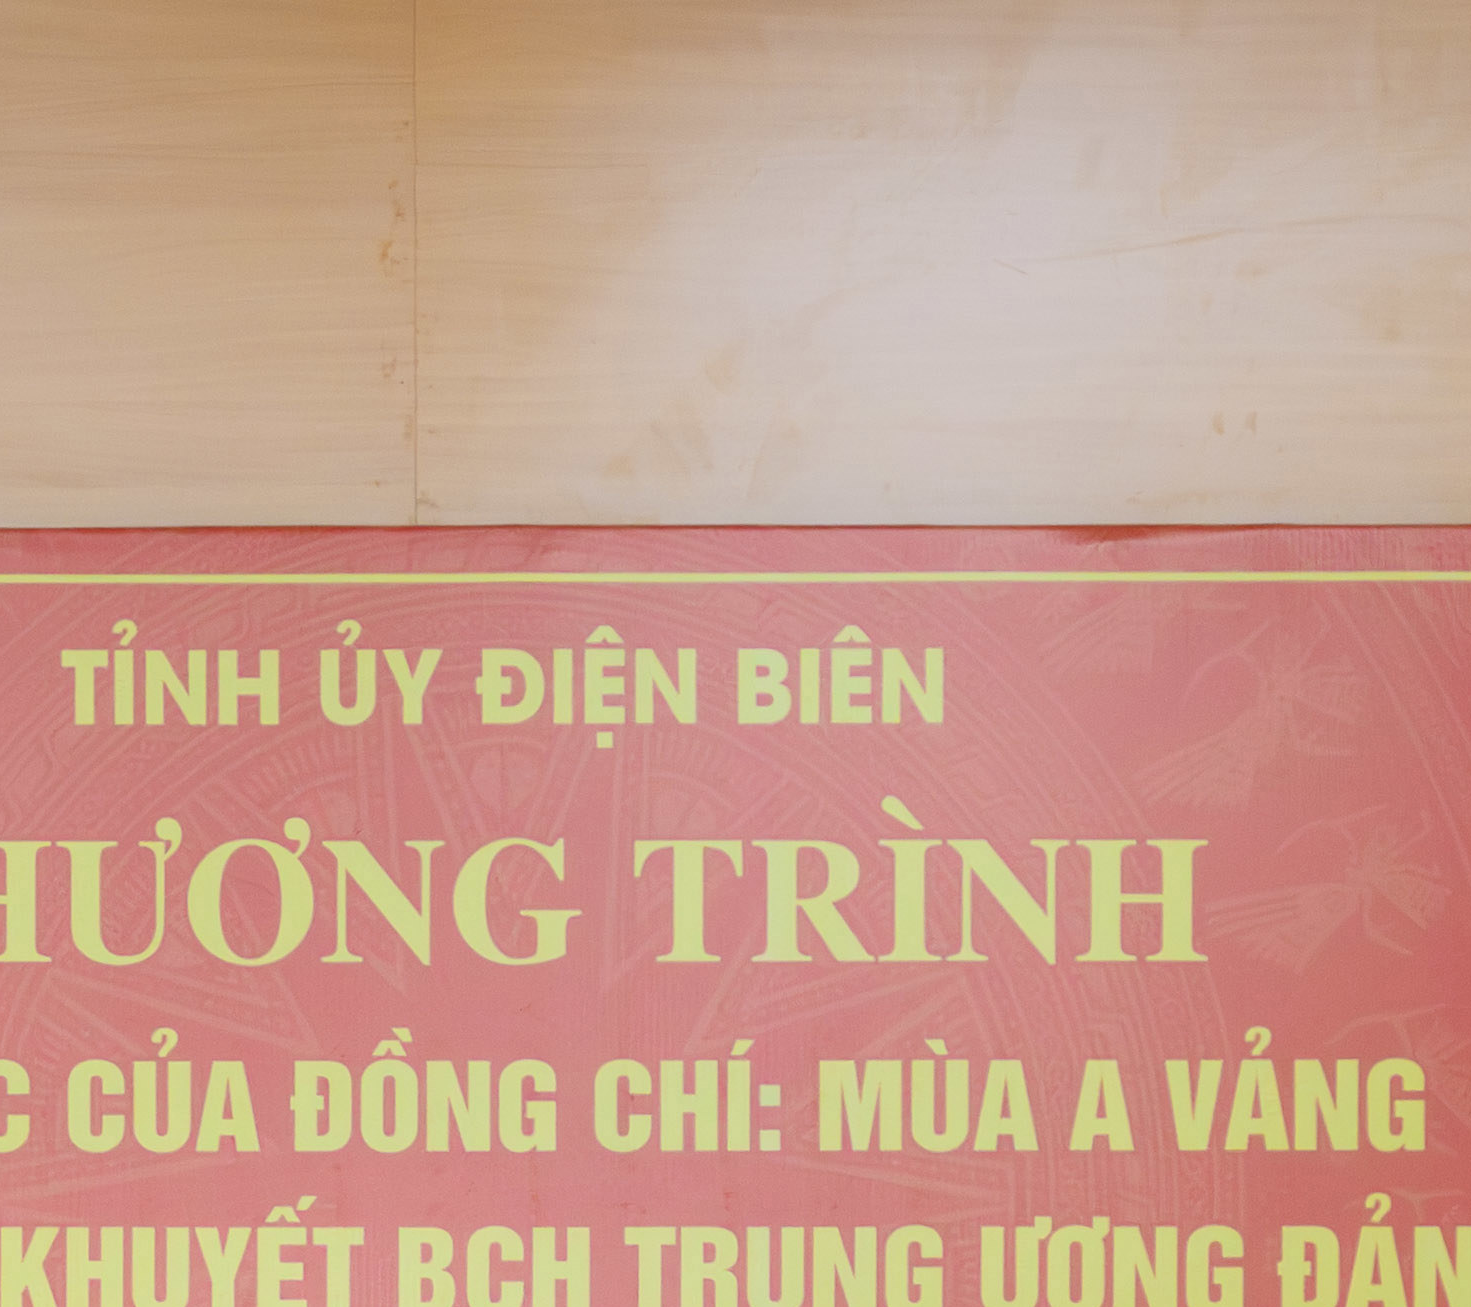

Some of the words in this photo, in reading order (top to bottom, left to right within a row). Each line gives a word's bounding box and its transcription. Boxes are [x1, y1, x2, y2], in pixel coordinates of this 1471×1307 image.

[61, 619, 279, 726] TỈNH
[320, 619, 441, 726] ỦY
[475, 626, 696, 749] ĐIỆN
[738, 626, 943, 724] BIÊN
[634, 797, 1207, 964] TRÌNH
[67, 1028, 259, 1153] CỦA
[290, 1027, 557, 1153] ĐỒNG
[594, 1039, 781, 1153] CHÍ:
[819, 1039, 1038, 1152] MÙA
[1069, 1059, 1134, 1151] A
[1165, 1027, 1425, 1152] VẢNG
